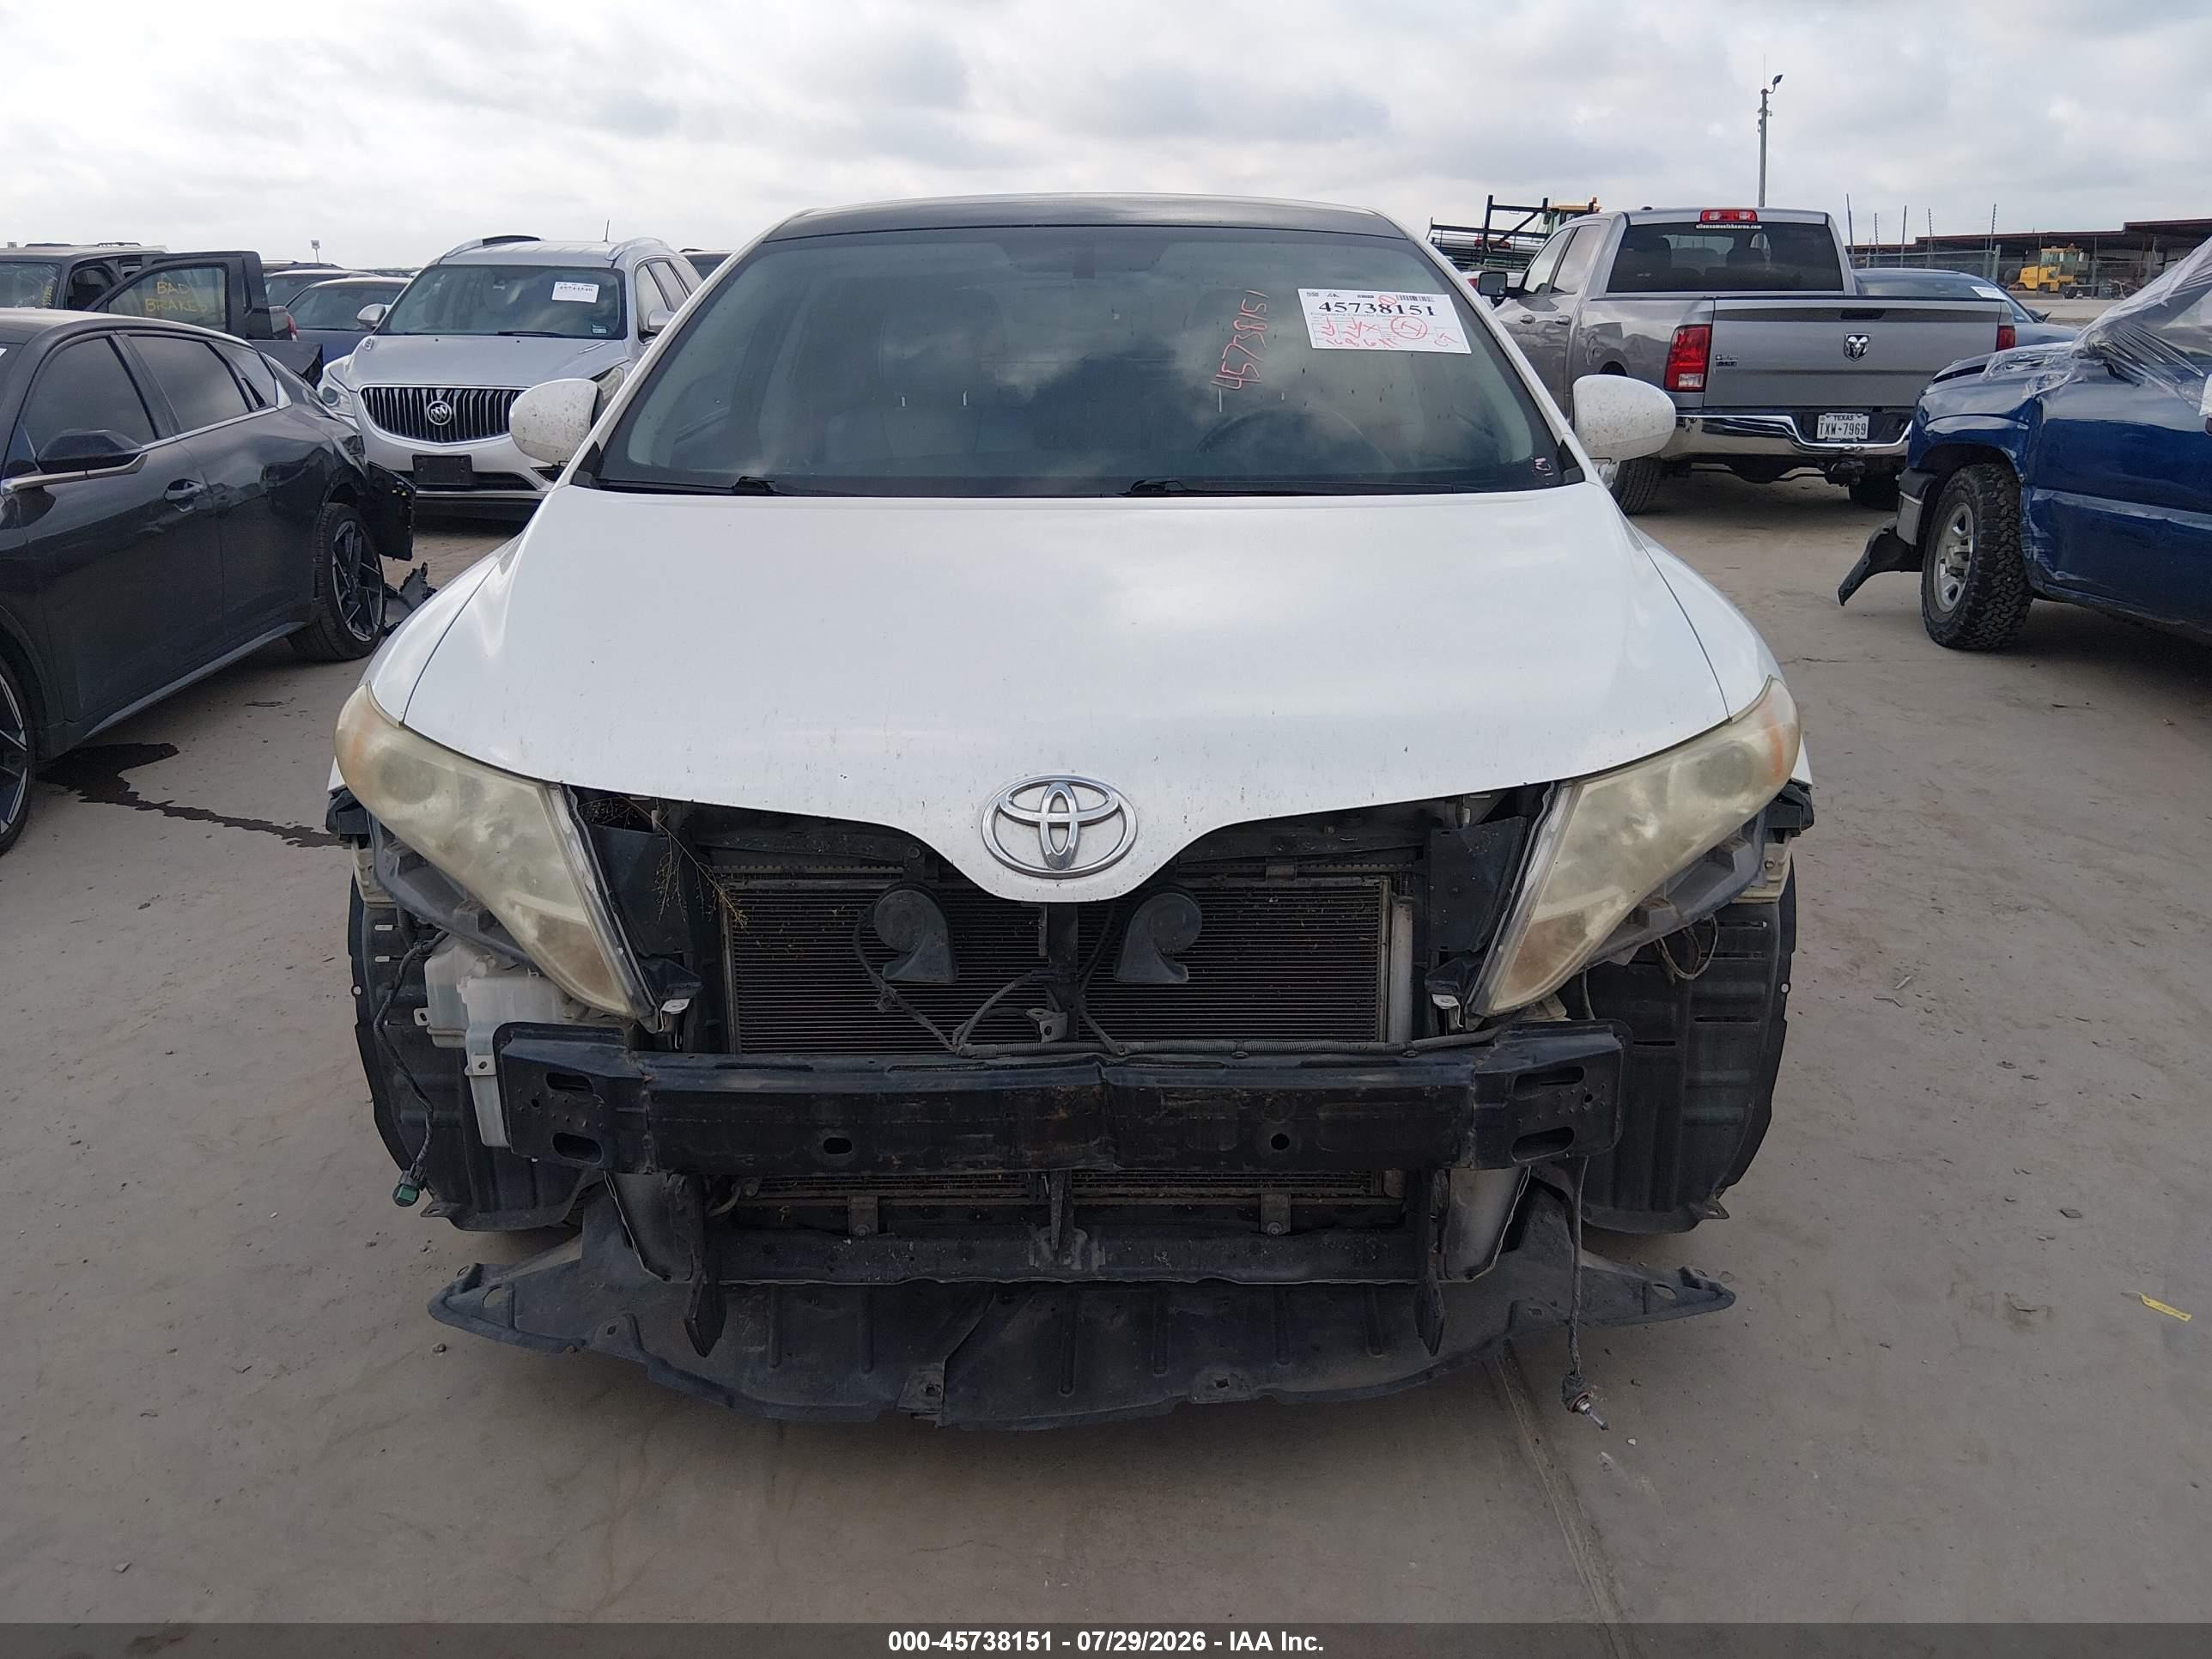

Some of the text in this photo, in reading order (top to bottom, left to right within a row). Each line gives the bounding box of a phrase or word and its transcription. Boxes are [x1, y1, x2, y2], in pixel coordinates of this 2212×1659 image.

[156, 281, 190, 295] BAD
[144, 298, 209, 312] BRAKES
[1318, 301, 1437, 316] 45738151
[1210, 289, 1269, 390] 45738151
